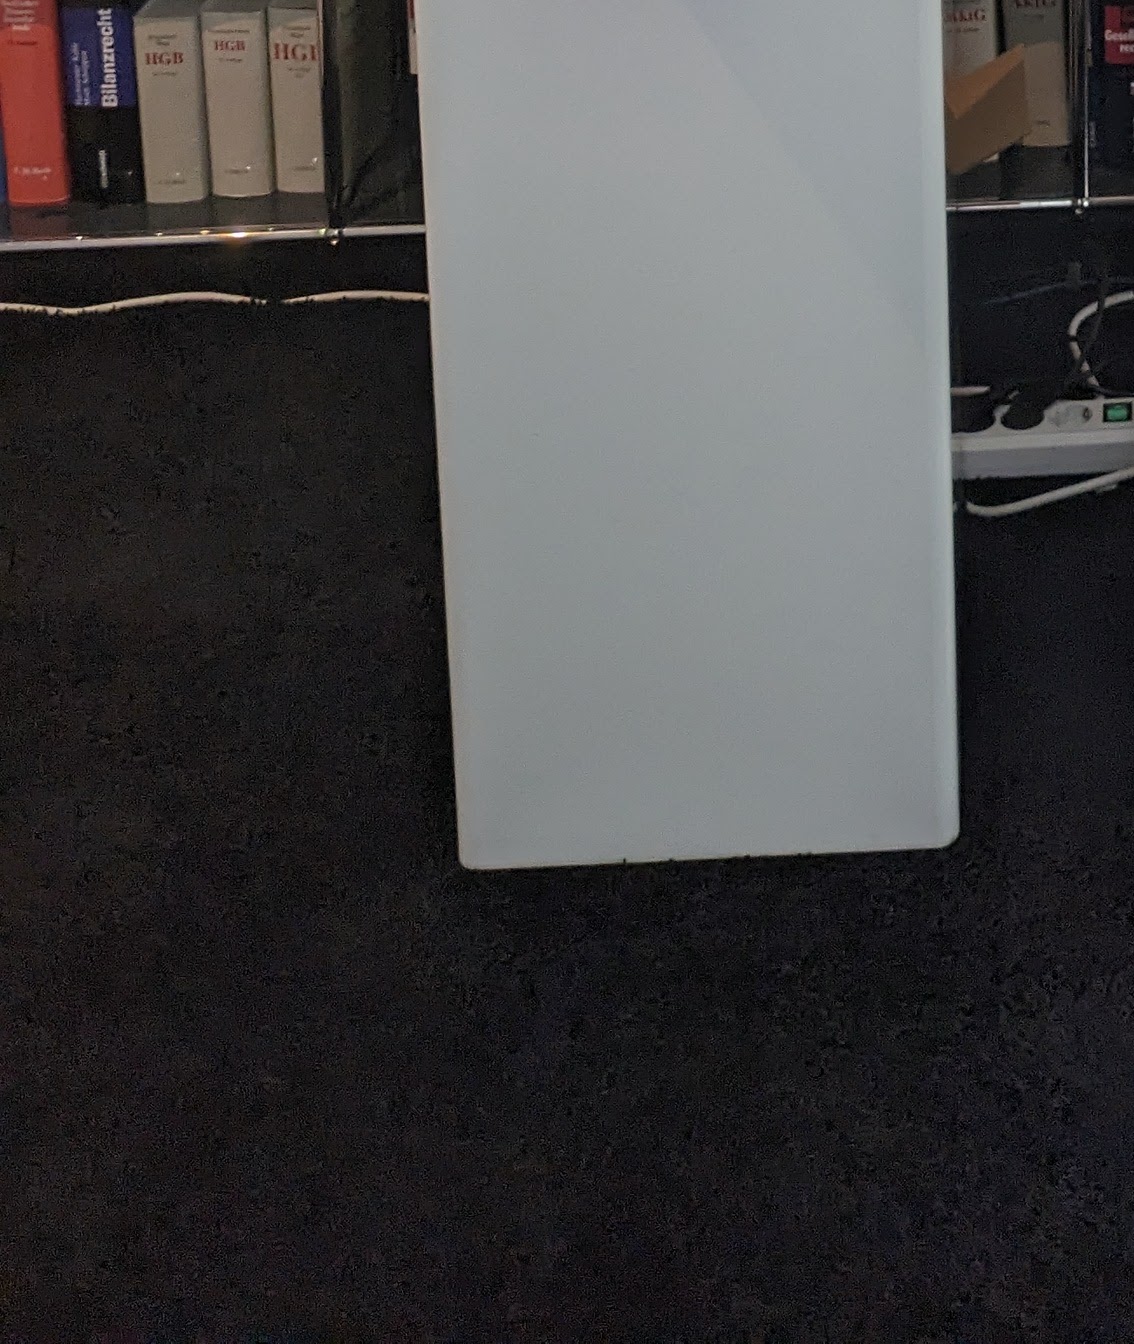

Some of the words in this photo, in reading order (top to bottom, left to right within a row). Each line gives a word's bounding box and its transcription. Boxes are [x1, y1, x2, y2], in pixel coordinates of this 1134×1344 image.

[214, 40, 246, 52] HGB
[97, 8, 118, 108] Bilanzrecht
[144, 52, 183, 65] HGB
